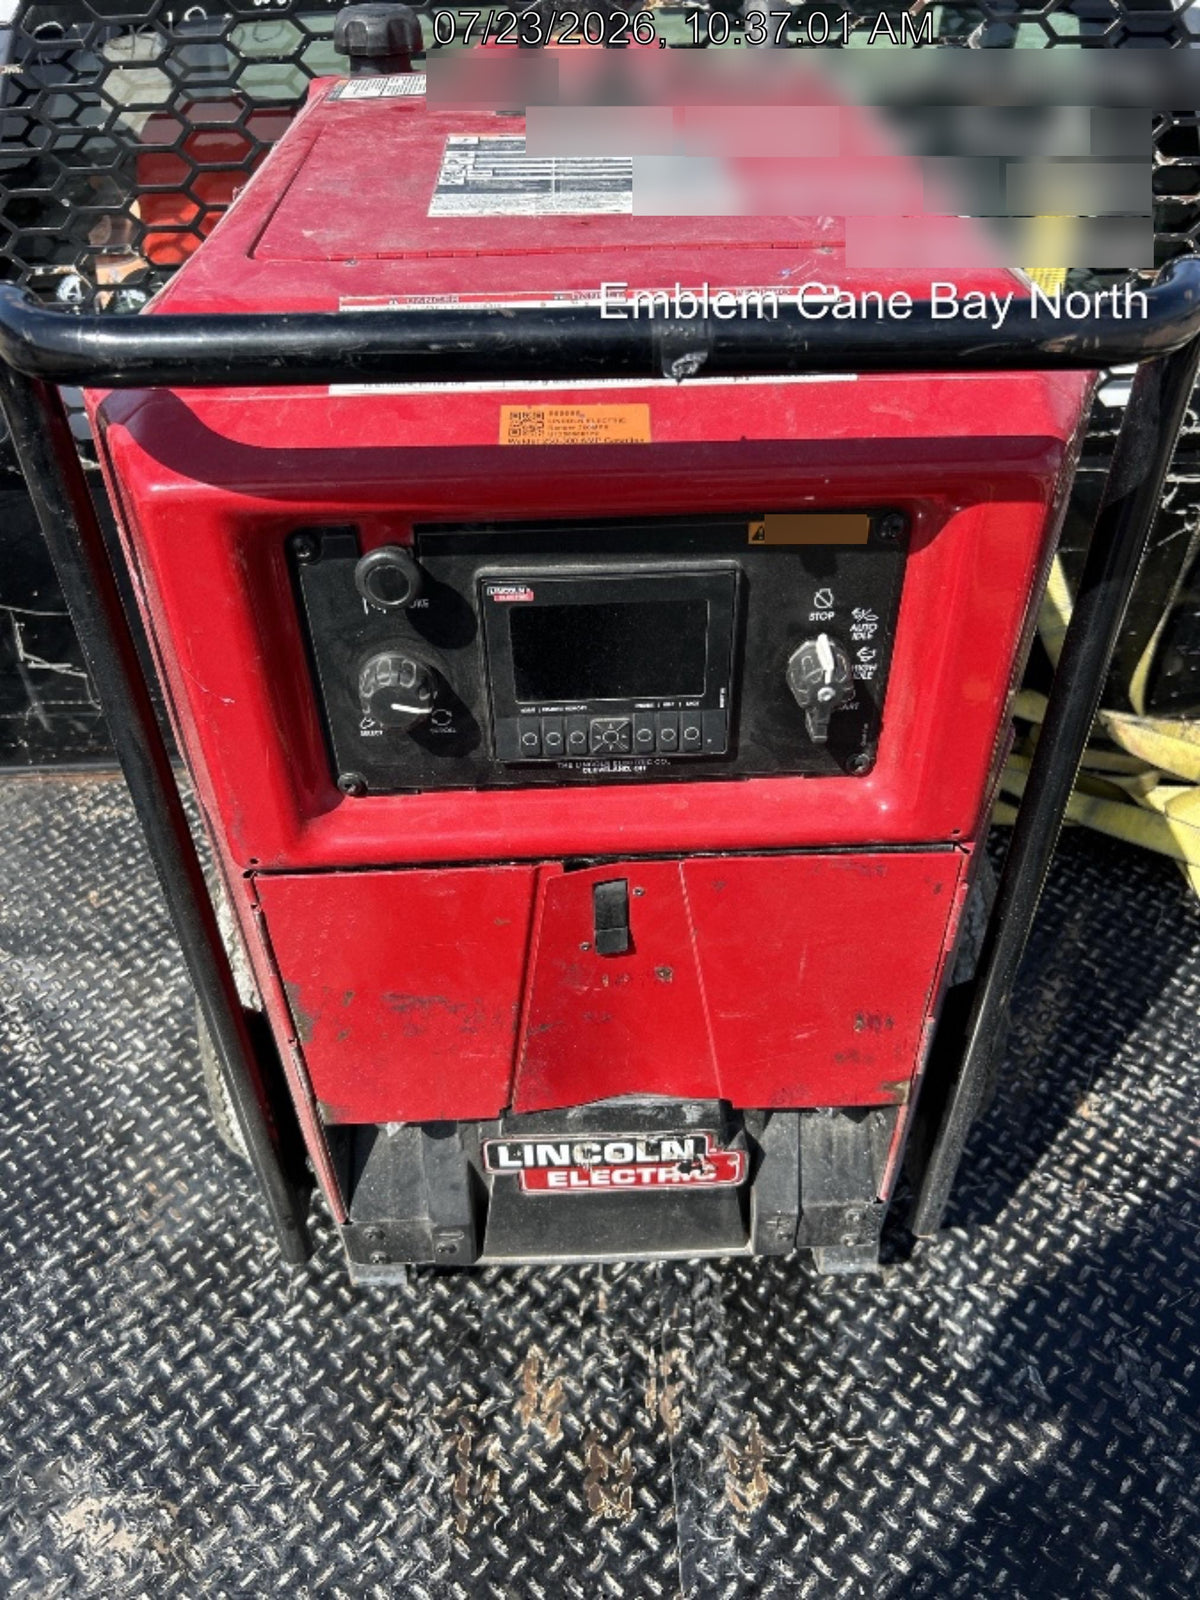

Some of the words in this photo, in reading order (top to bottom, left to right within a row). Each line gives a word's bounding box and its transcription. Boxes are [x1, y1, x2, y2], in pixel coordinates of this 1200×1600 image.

[808, 611, 835, 621] STOP
[849, 623, 878, 633] AUTO
[851, 632, 874, 641] IDLE
[496, 1138, 695, 1168] LINCOLN
